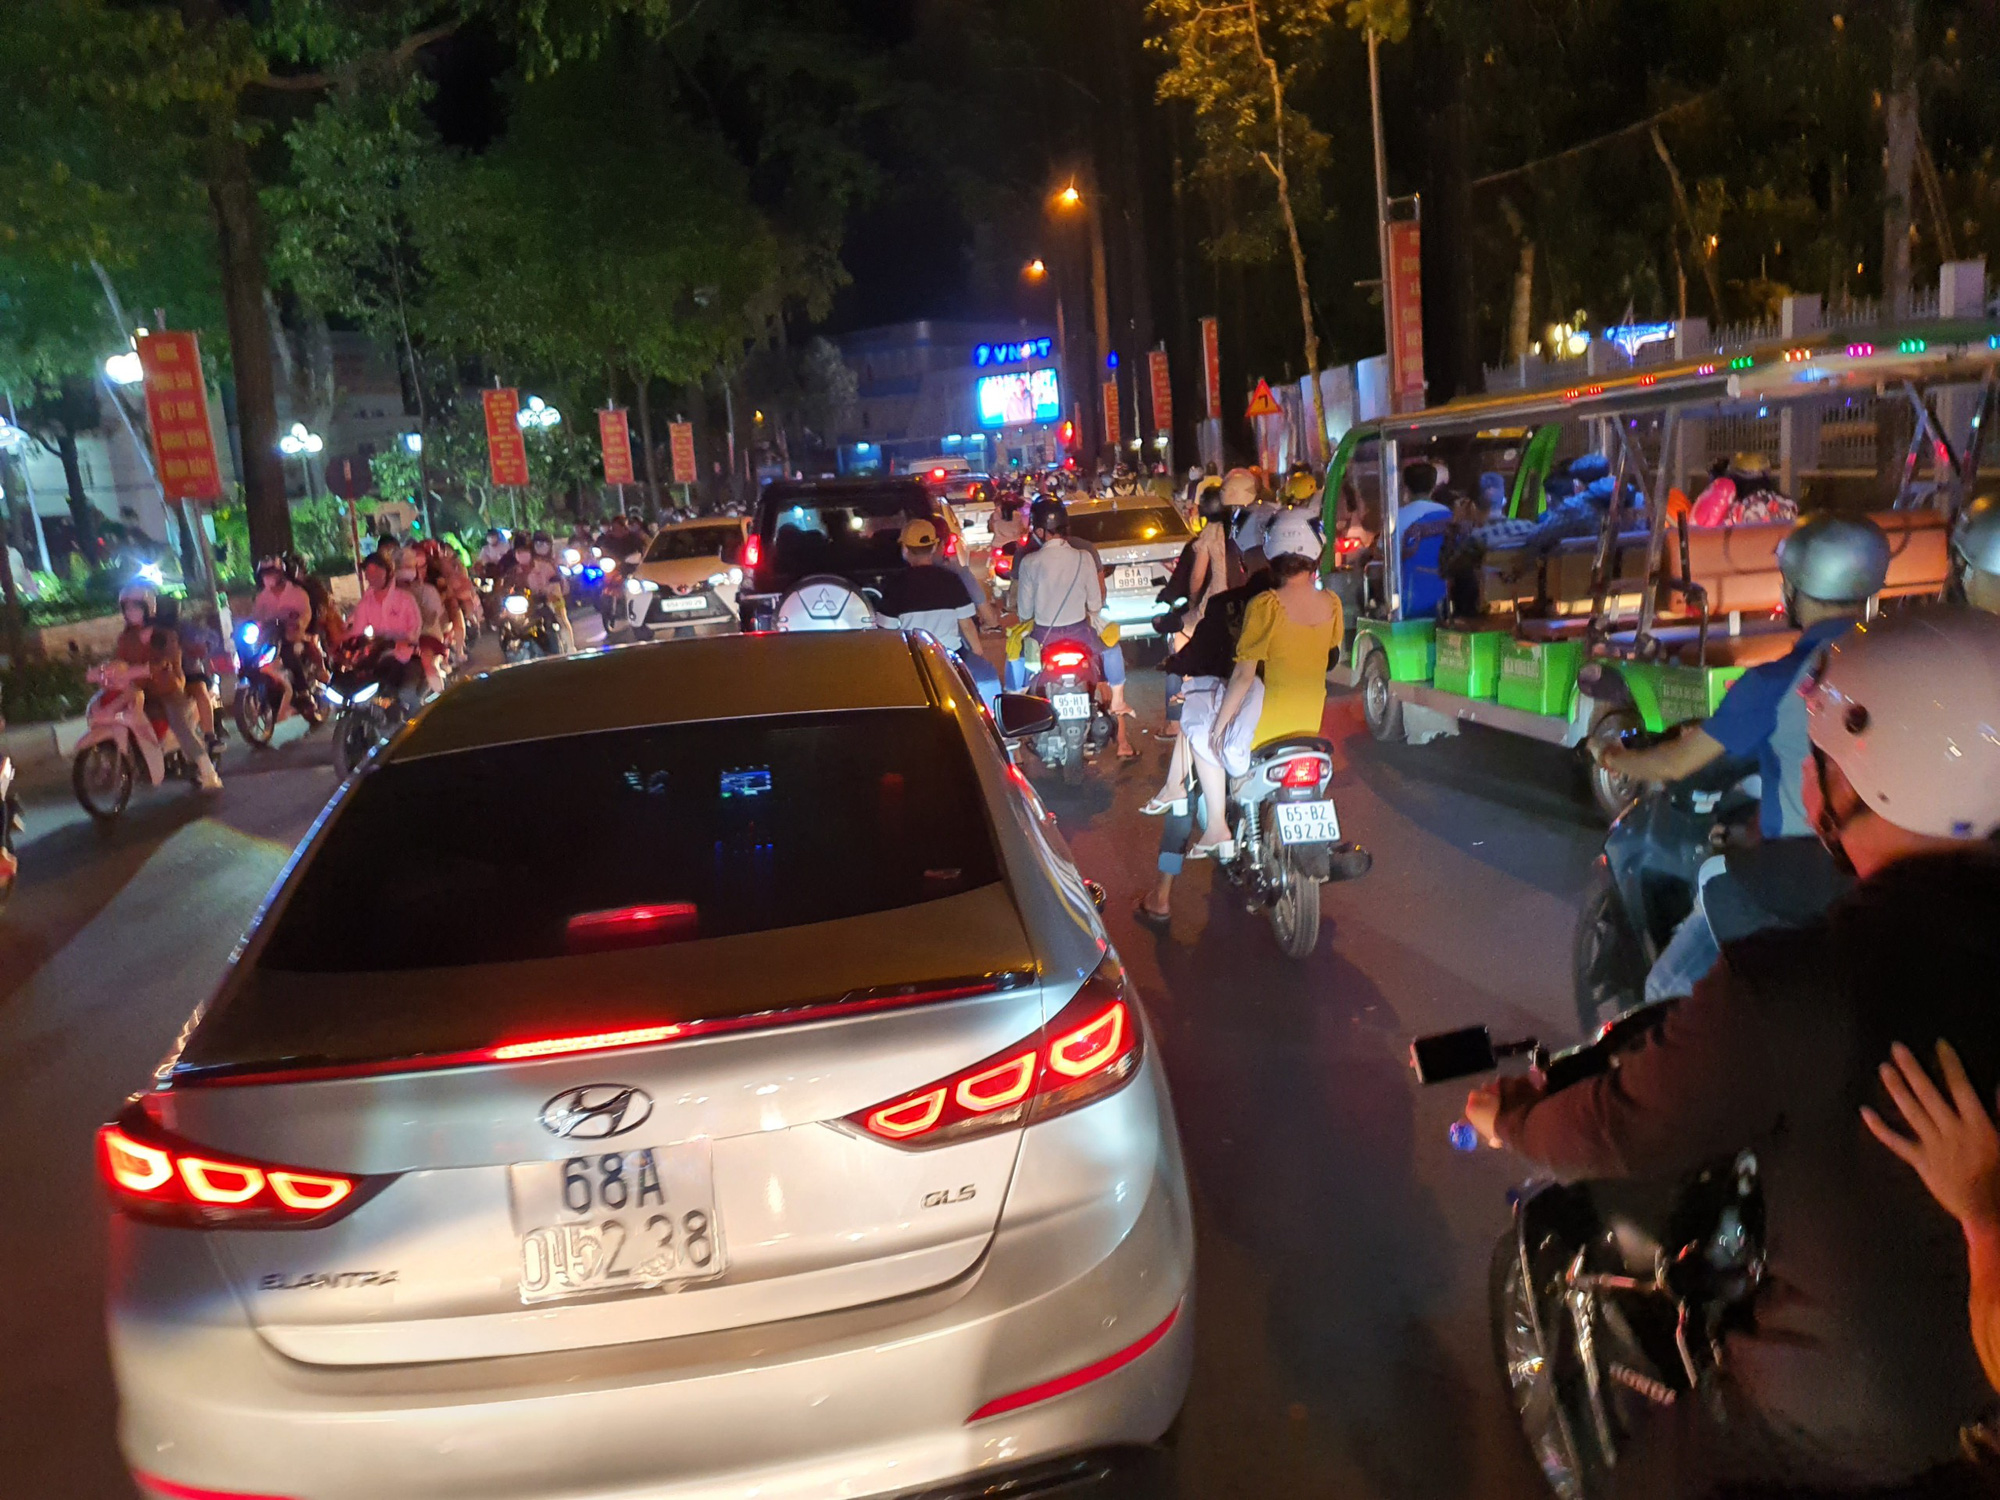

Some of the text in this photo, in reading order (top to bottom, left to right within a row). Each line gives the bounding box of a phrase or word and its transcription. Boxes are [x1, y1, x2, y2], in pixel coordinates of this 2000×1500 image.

[1124, 569, 1142, 578] 61A
[1283, 822, 1336, 840] 692.26
[561, 1147, 665, 1214] 68A
[921, 1183, 976, 1209] GLS
[259, 1269, 399, 1291] ELANTRA
